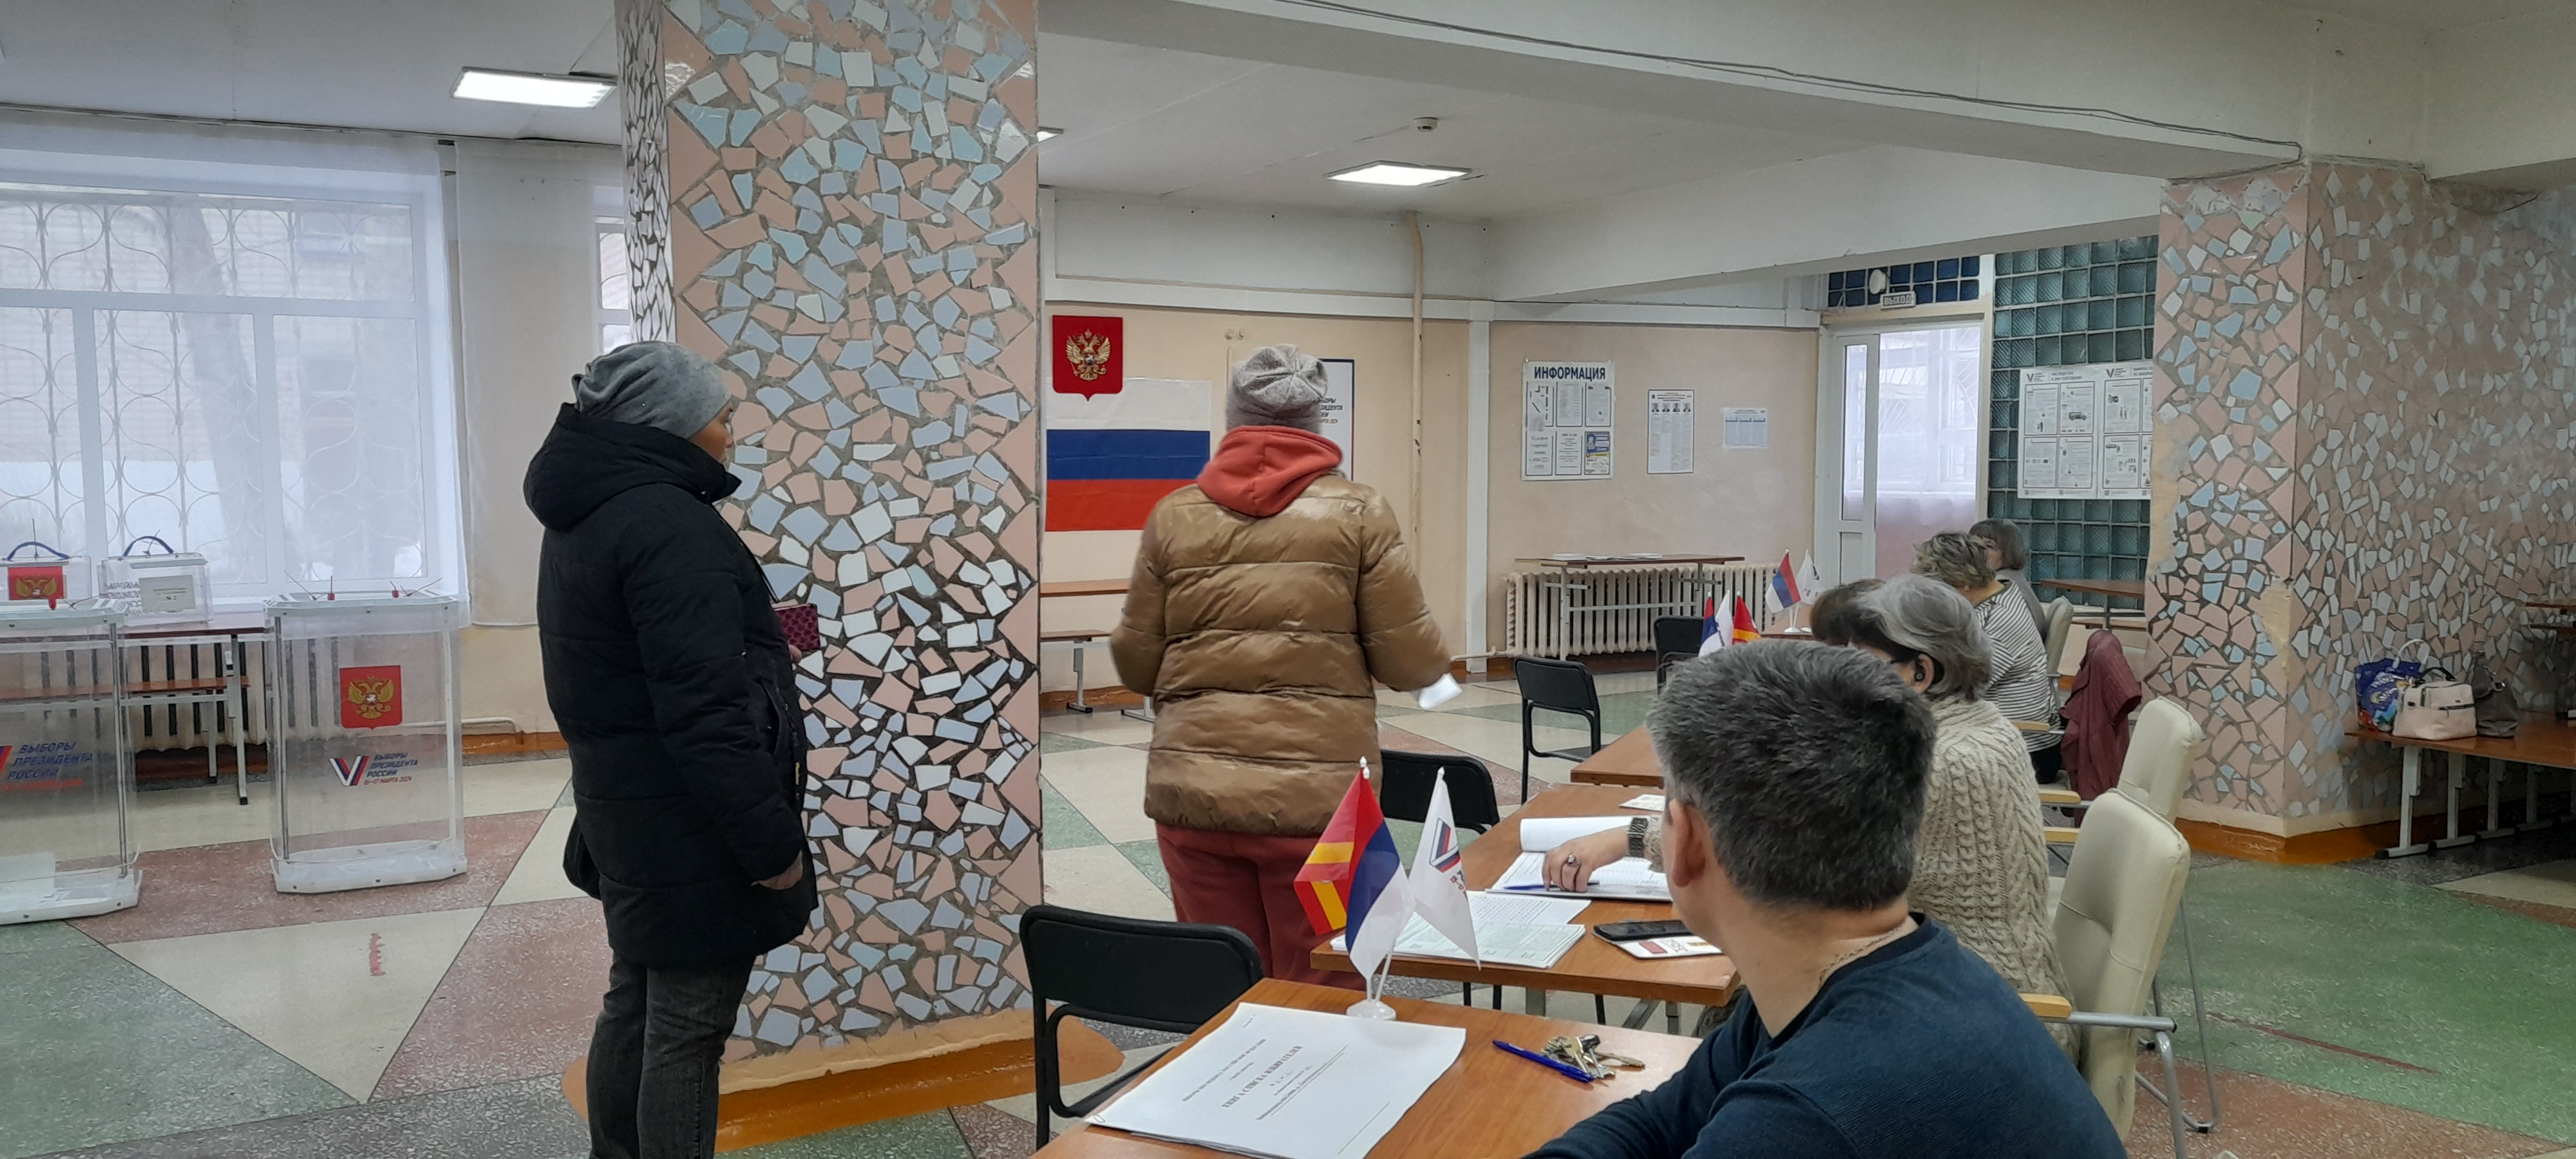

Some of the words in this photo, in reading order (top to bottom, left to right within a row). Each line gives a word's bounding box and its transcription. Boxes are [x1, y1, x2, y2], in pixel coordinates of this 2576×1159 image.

[1884, 294, 1911, 305] ВЫХОД
[1534, 366, 1605, 382] ИНФОРМАЦИЯ
[19, 741, 78, 753] ВЫБОРЫ
[12, 753, 93, 766] ПРЕЗИДЕНТА
[369, 759, 418, 769] ПРЕЗИДЕНТА
[7, 768, 59, 780] РОССИИ
[366, 769, 398, 778] РОССИИ
